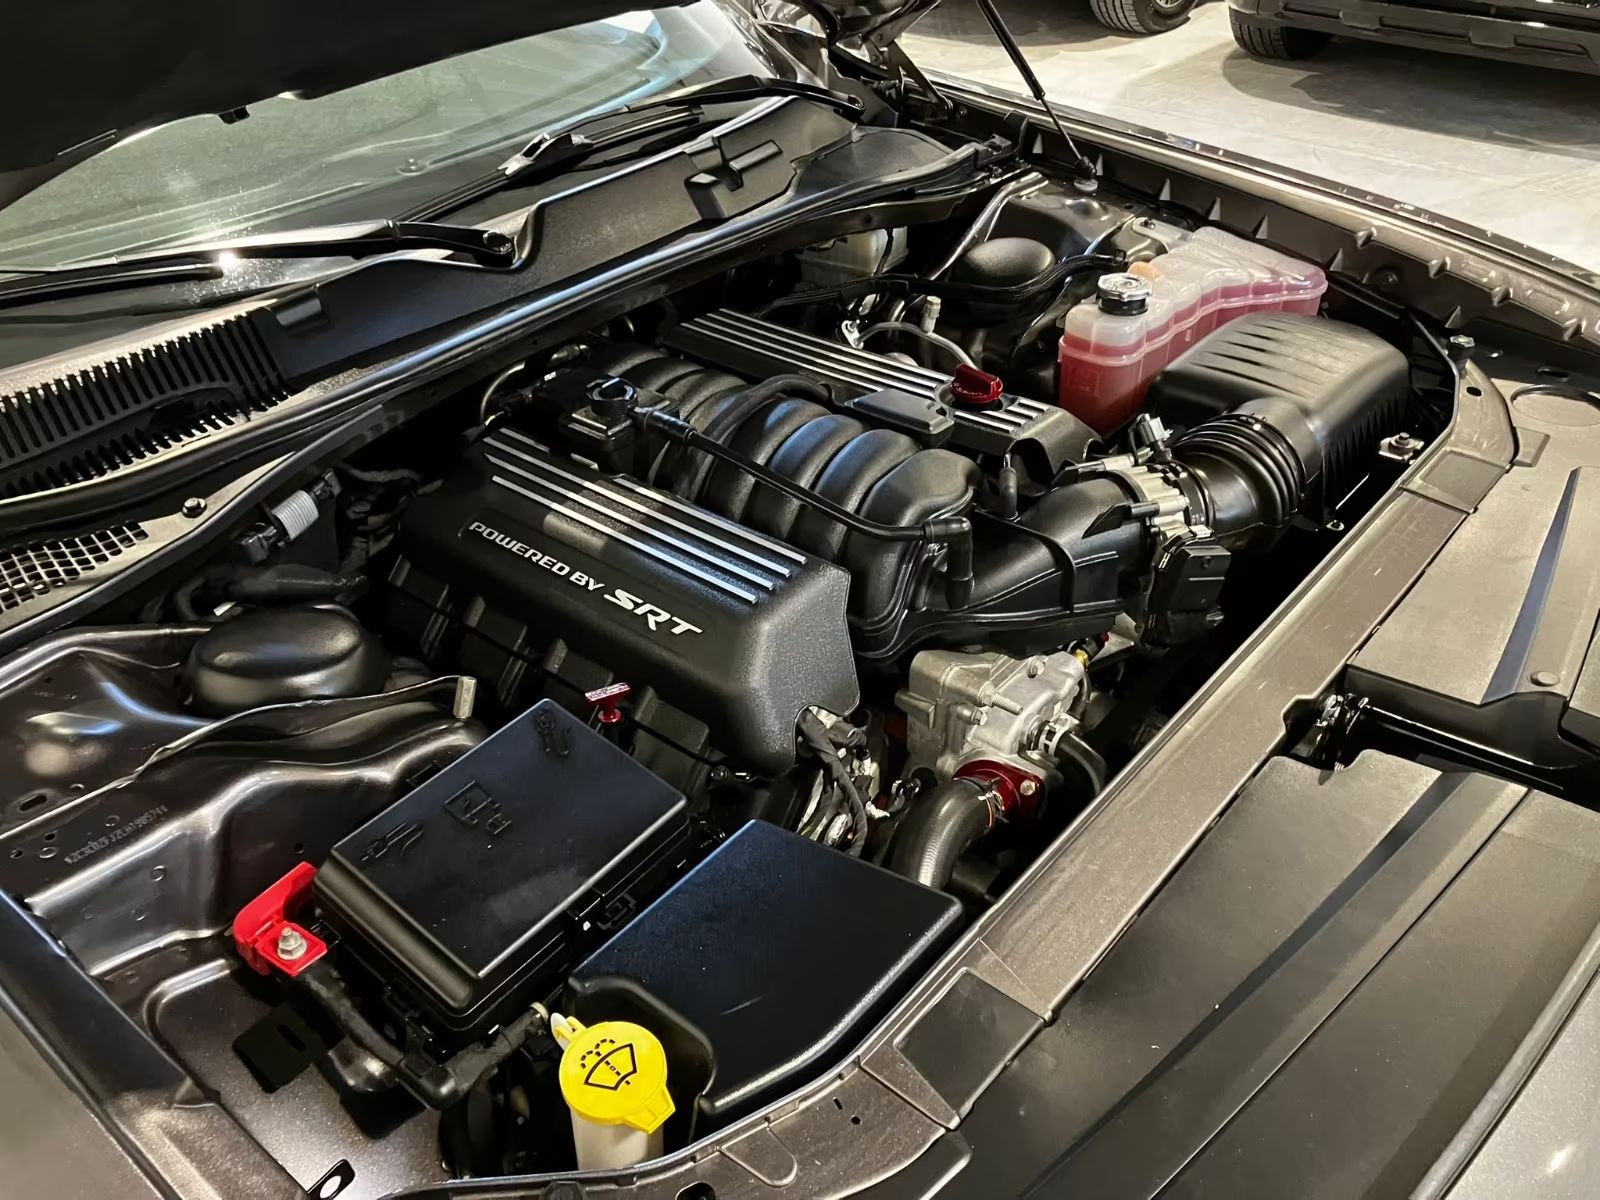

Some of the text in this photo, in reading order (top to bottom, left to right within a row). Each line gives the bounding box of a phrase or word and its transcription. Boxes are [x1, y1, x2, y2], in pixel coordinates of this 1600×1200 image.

[468, 521, 703, 636] POWERED BY SRT
